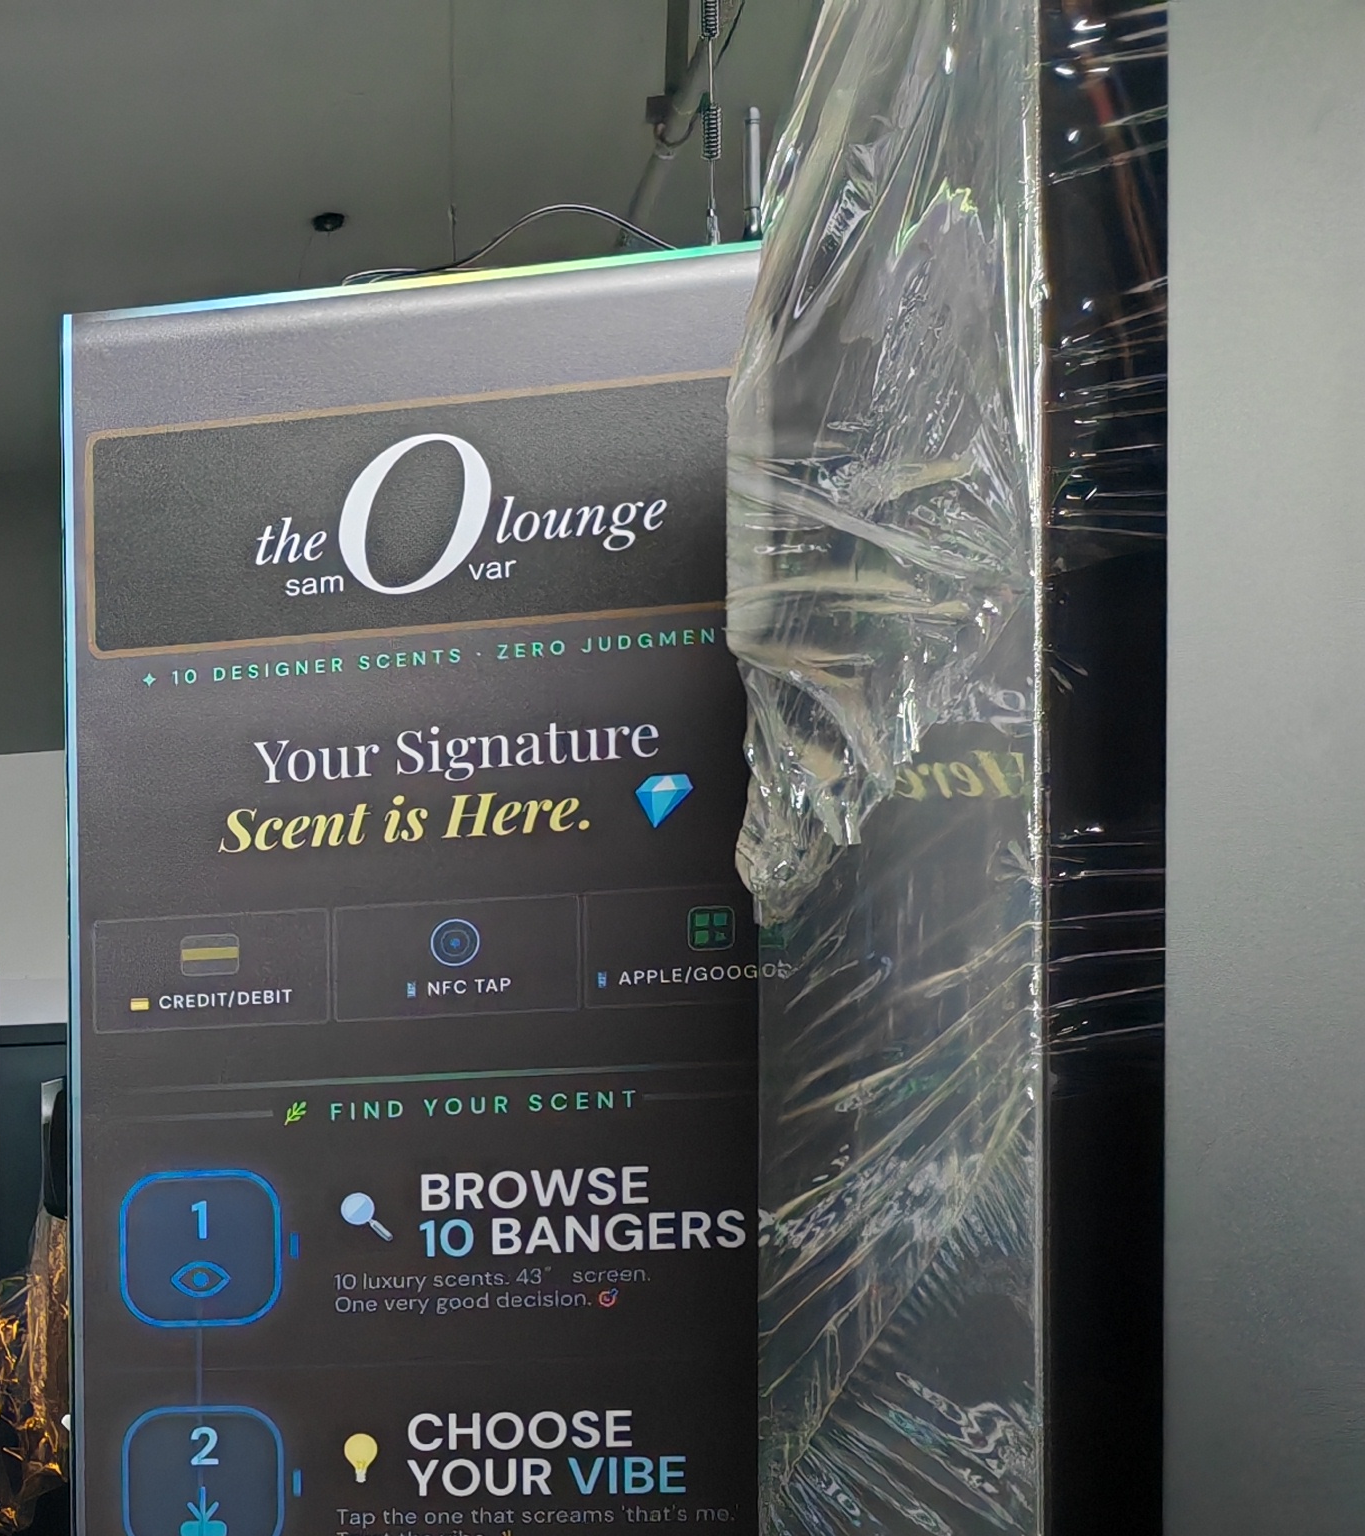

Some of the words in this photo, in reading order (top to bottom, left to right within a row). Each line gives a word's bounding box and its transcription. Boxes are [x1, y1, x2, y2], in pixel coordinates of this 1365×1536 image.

[255, 516, 327, 566] the
[338, 432, 493, 595] O
[495, 495, 668, 551] lounge
[285, 574, 344, 599] sam
[468, 557, 517, 581] var
[171, 668, 198, 686] 10
[213, 655, 344, 682] DESIGNER
[358, 648, 463, 670] SCENTS
[497, 639, 567, 659] ZERO
[581, 626, 725, 655] JUDGMEN
[253, 738, 380, 785] Your
[395, 721, 660, 781] Signature
[218, 804, 373, 855] Scent
[383, 796, 429, 842] is
[441, 792, 592, 841] Here.
[158, 988, 293, 1010] CREDIT/DEBIT
[427, 977, 468, 997] NFC
[471, 976, 512, 994] TAP
[330, 1100, 405, 1122] FIND
[423, 1094, 510, 1118] YOUR
[528, 1089, 639, 1113] SCENT
[420, 1165, 650, 1211] BROWSE
[190, 1201, 210, 1241] 1
[418, 1218, 474, 1259] 10
[491, 1209, 747, 1258] BANGERS
[334, 1273, 357, 1291] 10
[363, 1271, 426, 1293] luxury
[433, 1271, 510, 1288] scents.
[572, 1267, 651, 1284] screen.
[334, 1296, 377, 1314] One
[384, 1295, 429, 1314] very
[436, 1291, 490, 1314] good
[496, 1289, 591, 1309] decision.
[190, 1426, 220, 1466] 2
[407, 1409, 633, 1452] CHOOSE
[407, 1457, 553, 1498] YOUR
[568, 1454, 687, 1495] VIBE
[336, 1508, 376, 1529] Tap
[383, 1508, 417, 1525] the
[424, 1510, 464, 1525] one
[471, 1508, 514, 1525] that
[522, 1509, 614, 1524] screams
